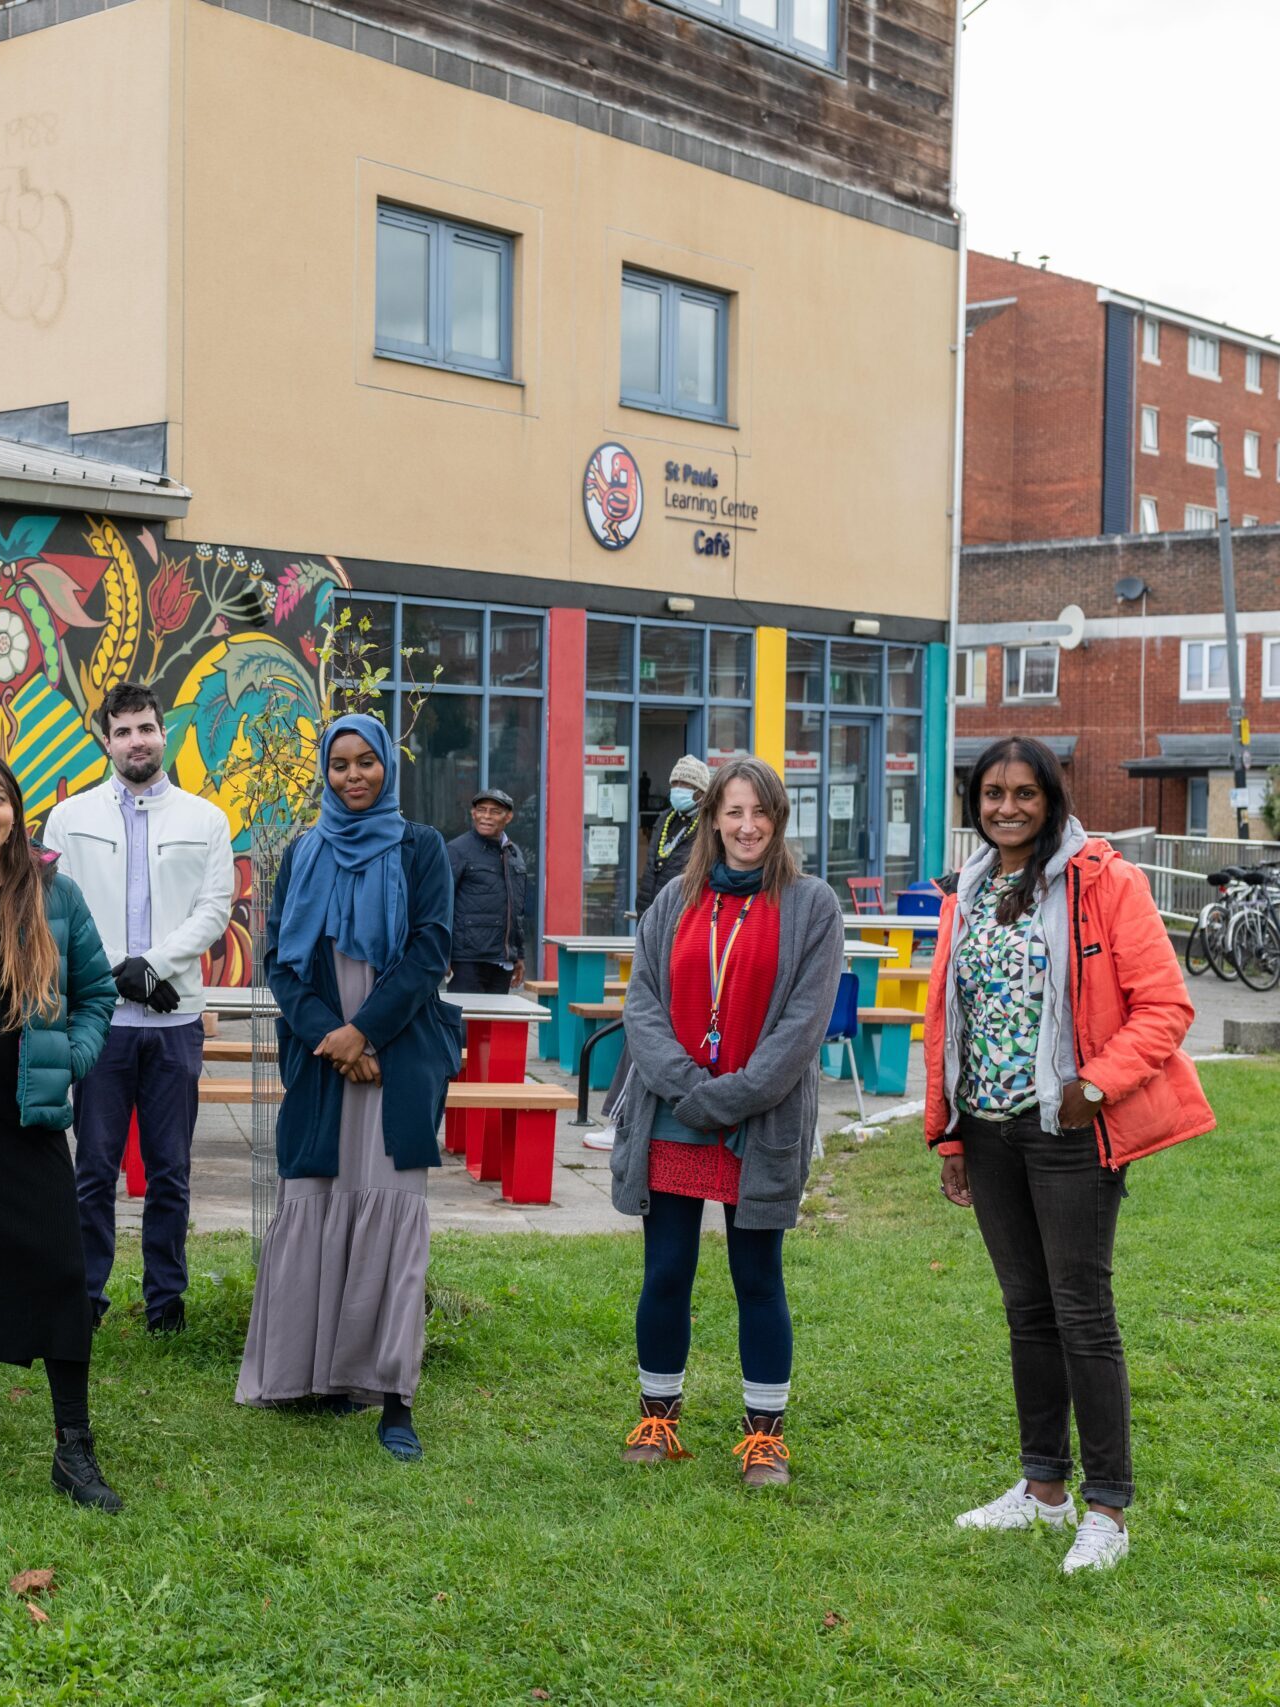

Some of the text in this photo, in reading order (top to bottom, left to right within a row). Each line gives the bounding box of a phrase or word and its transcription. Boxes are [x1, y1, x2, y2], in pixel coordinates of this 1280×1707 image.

[665, 461, 718, 489] St Pauls
[665, 486, 758, 521] Learning Centre
[694, 530, 731, 558] Café
